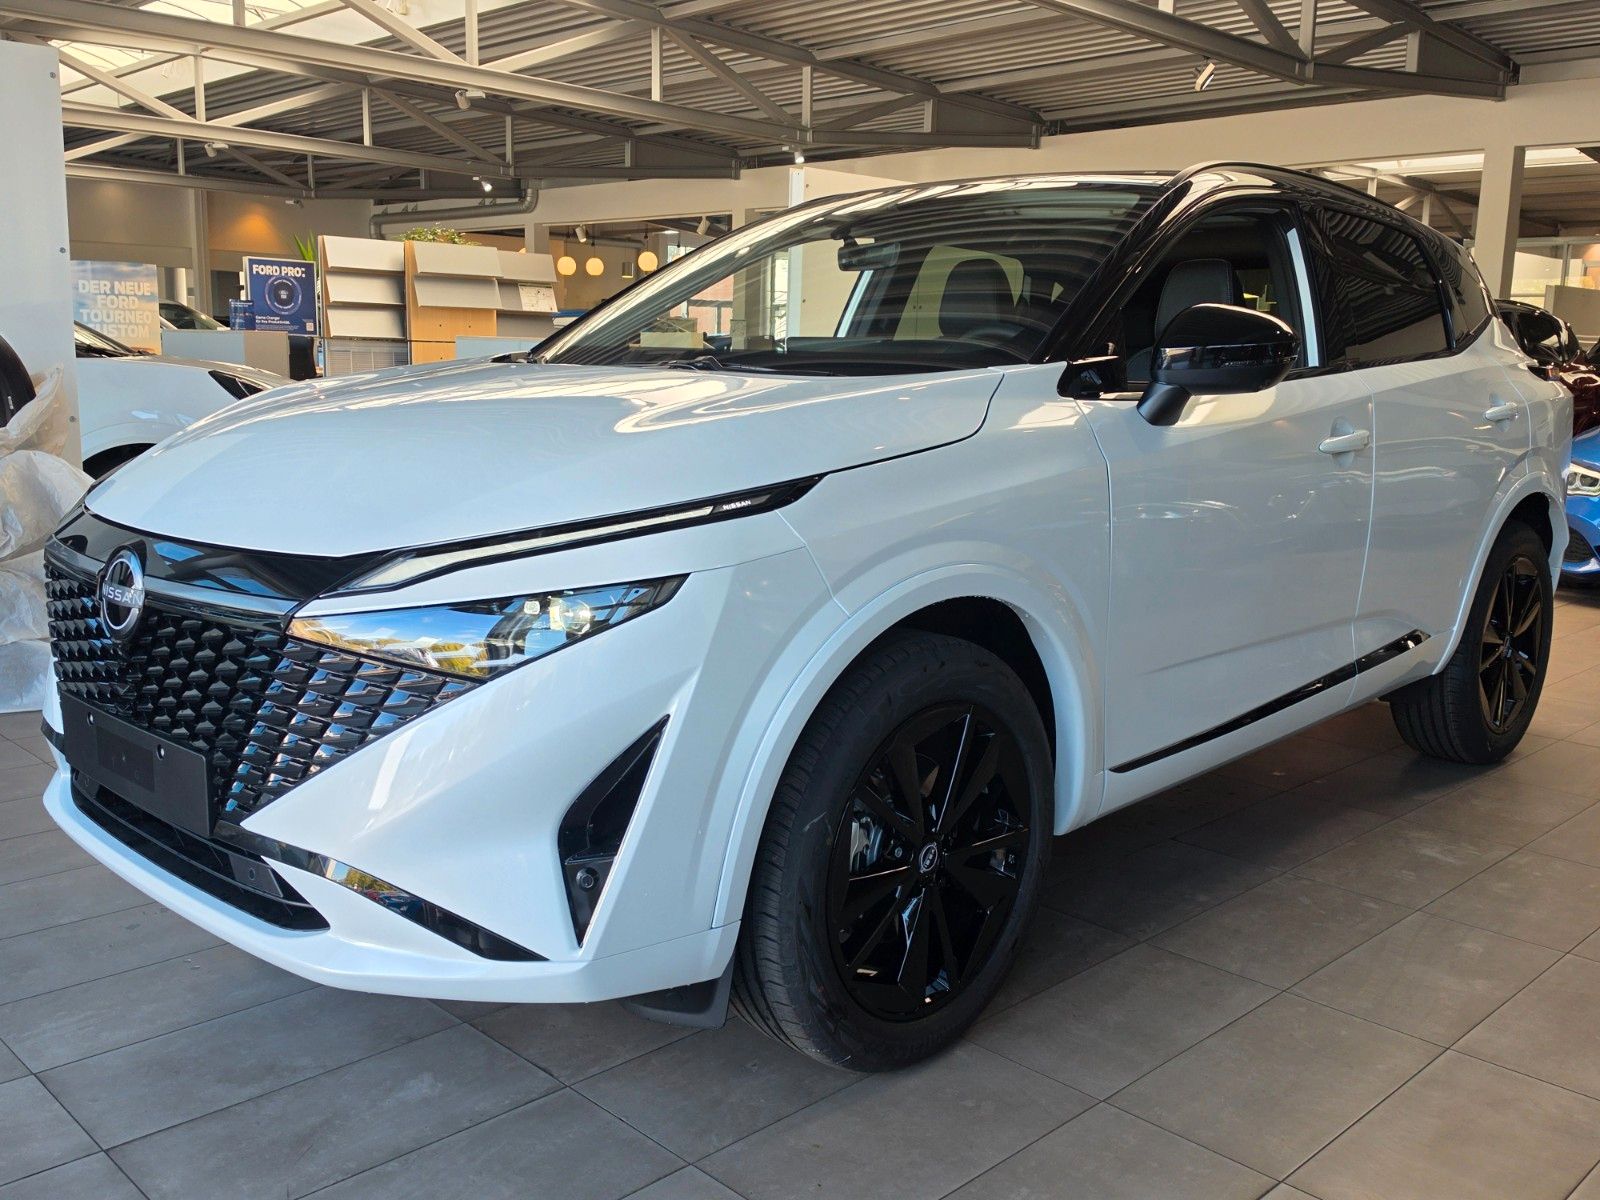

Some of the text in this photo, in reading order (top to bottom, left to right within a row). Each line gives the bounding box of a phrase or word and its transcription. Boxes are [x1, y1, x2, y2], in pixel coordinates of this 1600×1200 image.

[252, 264, 280, 276] FORD
[78, 279, 152, 295] DER NEUE
[96, 294, 139, 310] FORD
[79, 308, 153, 324] TOURNEO
[87, 323, 150, 339] USTOM
[722, 499, 752, 511] NISSAN
[102, 582, 143, 605] NISSAN
